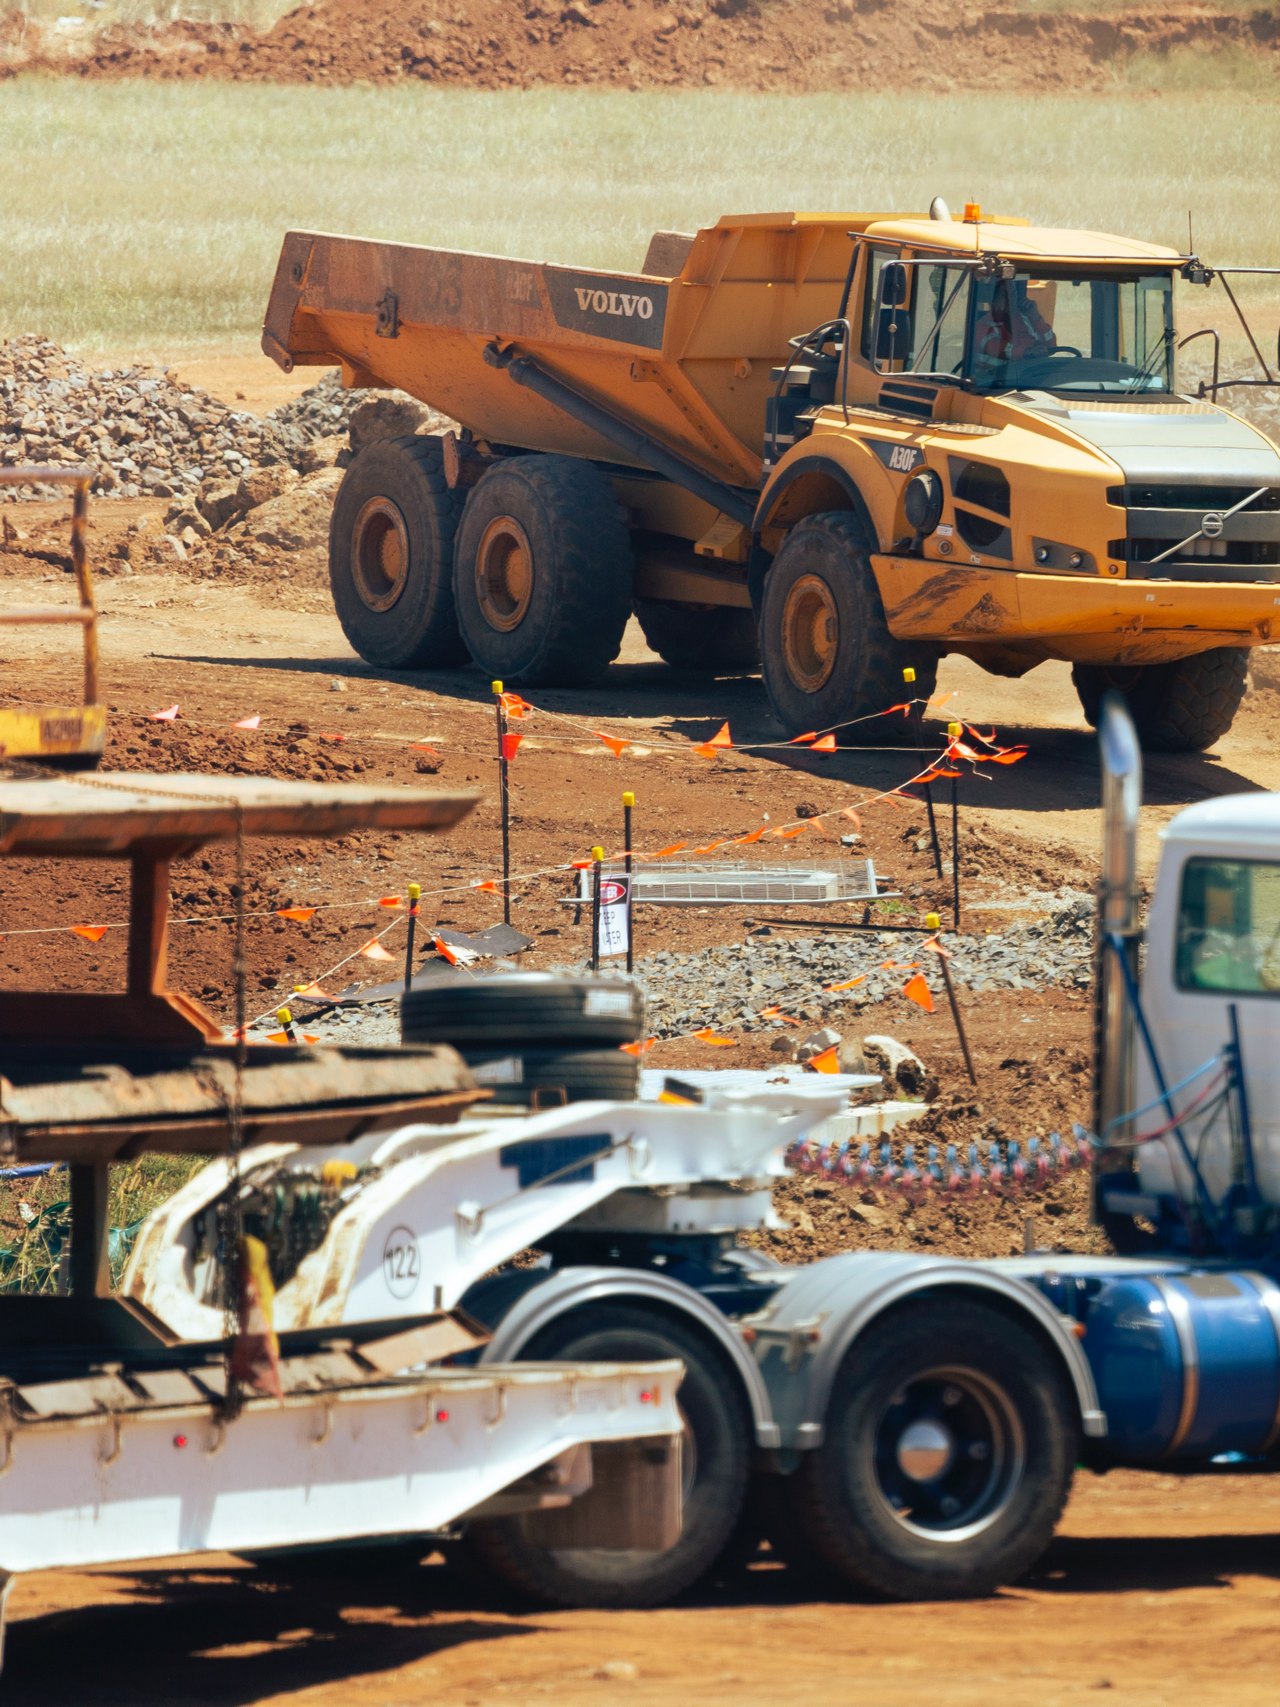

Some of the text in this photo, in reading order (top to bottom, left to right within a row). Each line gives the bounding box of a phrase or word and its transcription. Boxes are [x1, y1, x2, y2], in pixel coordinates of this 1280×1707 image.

[574, 287, 653, 319] VOLVO
[889, 446, 917, 471] A30F
[386, 1245, 418, 1279] 122
